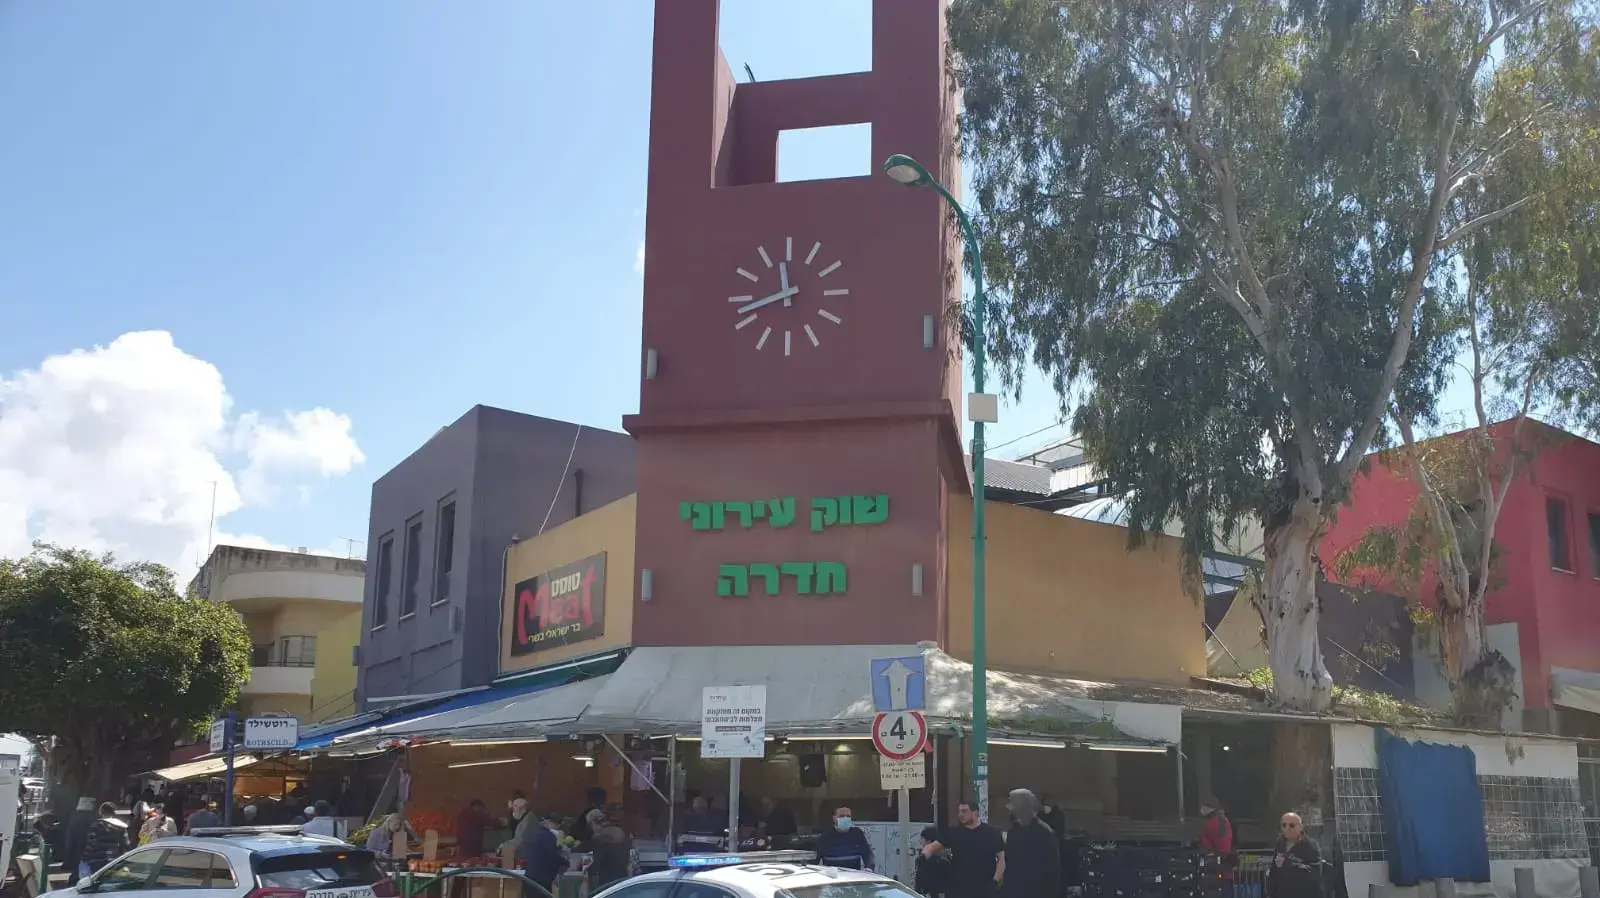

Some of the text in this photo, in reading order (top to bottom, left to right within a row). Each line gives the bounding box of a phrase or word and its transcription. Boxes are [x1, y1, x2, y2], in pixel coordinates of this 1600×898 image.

[679, 494, 889, 532] שוק עירוני
[551, 572, 581, 598] טוסט
[718, 561, 847, 596] חדרה
[517, 564, 597, 645] Meat
[528, 622, 581, 643] בר ישראלי בשרי
[248, 720, 289, 728] רוטשילד
[890, 716, 907, 741] 4
